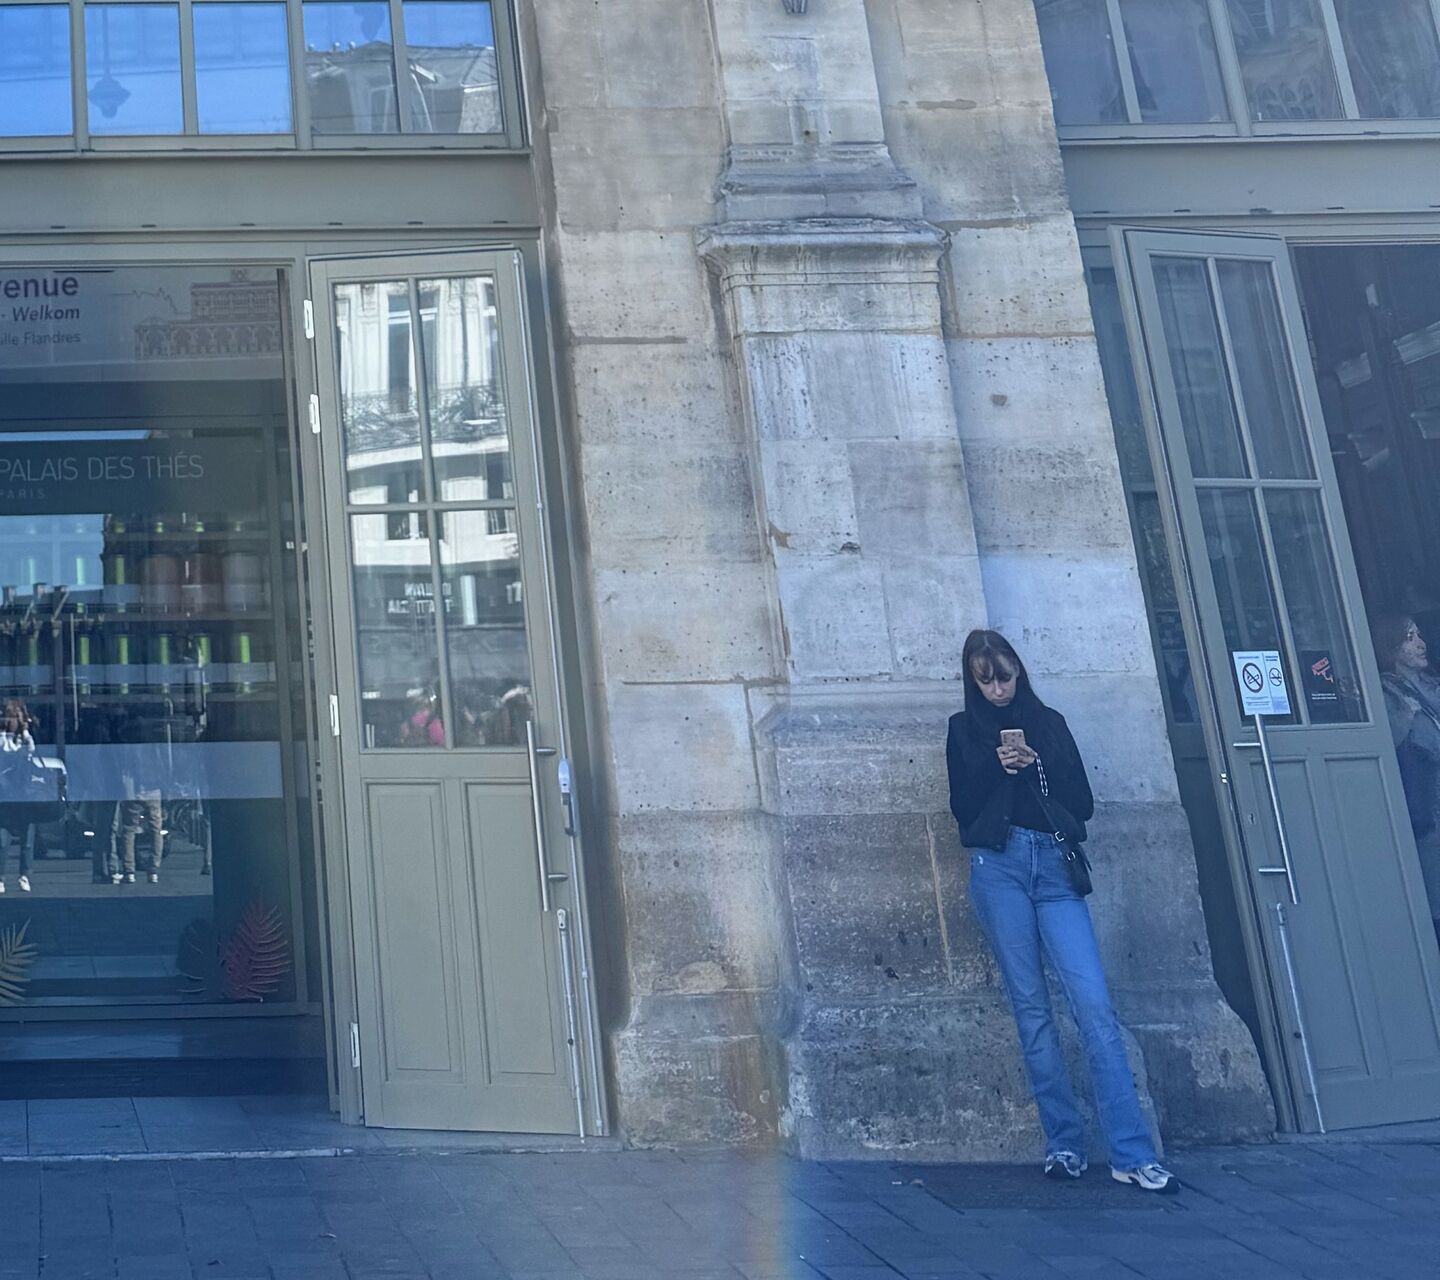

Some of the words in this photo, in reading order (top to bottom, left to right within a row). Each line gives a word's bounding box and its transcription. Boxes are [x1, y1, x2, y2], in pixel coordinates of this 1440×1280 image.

[12, 304, 80, 322] Welkom
[23, 329, 81, 345] Flandres
[88, 456, 135, 480] DES
[141, 451, 205, 479] THÉS
